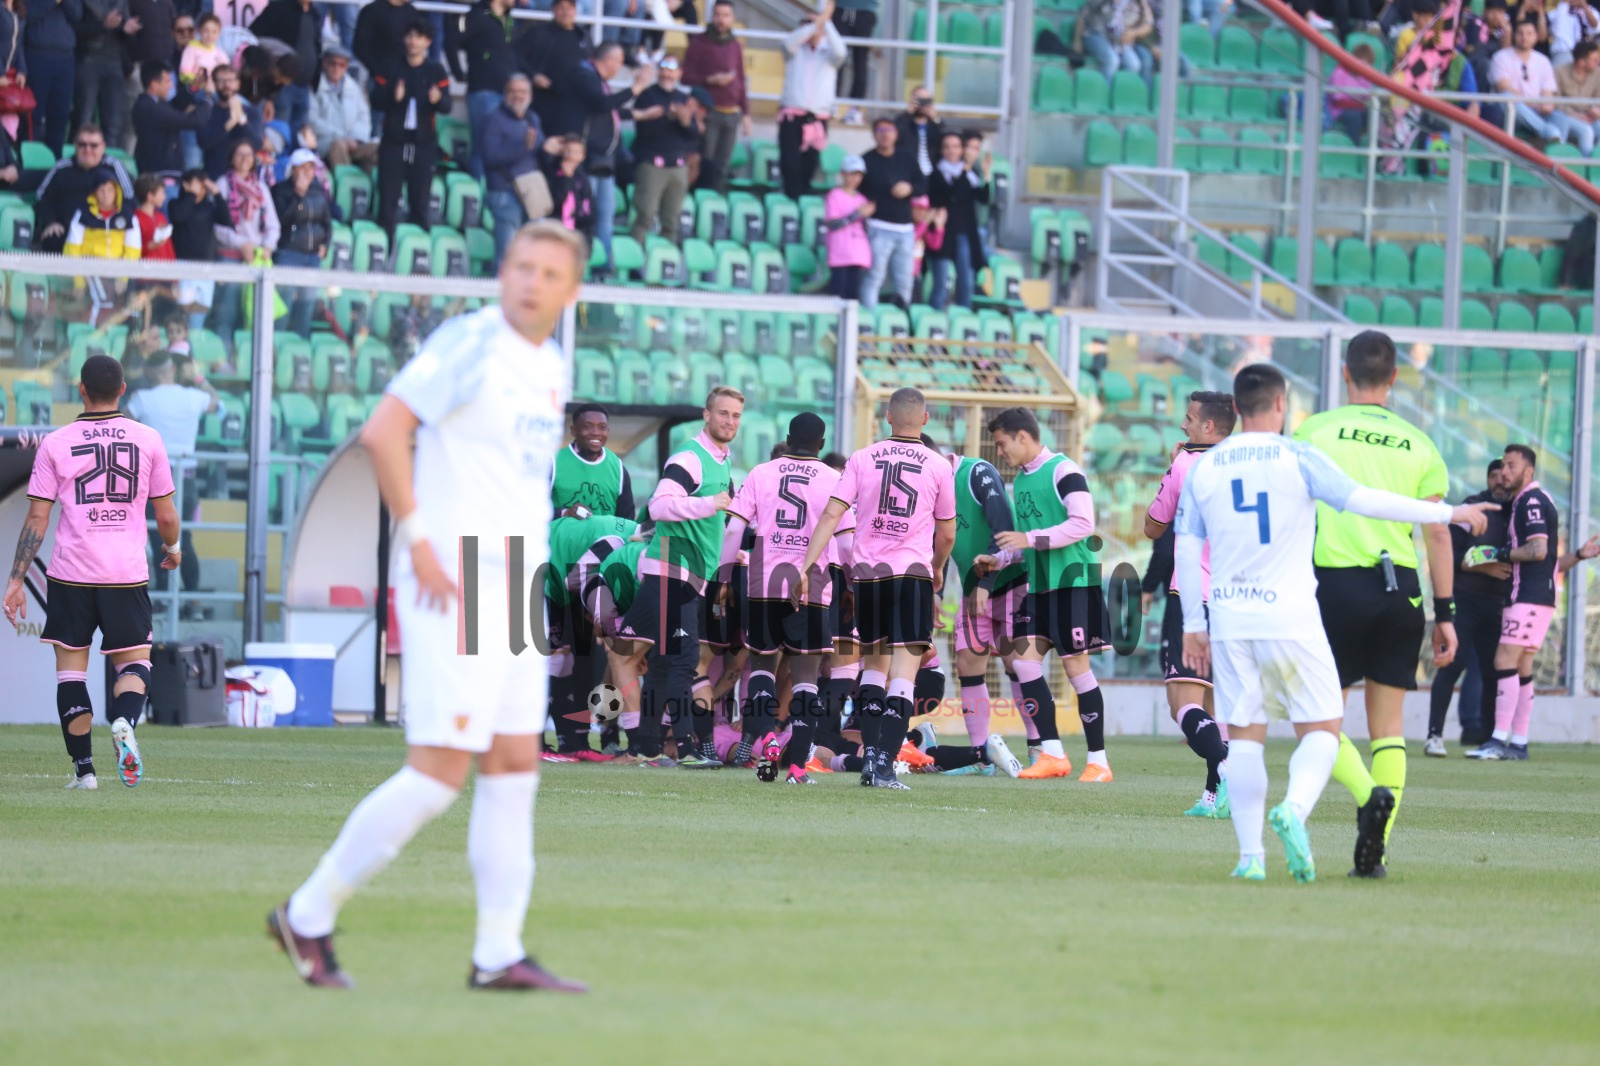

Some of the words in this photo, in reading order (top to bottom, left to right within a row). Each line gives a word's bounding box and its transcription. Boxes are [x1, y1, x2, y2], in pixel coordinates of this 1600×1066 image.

[82, 427, 126, 440] SARIC
[1338, 427, 1411, 451] LEGEA
[870, 446, 928, 465] MARCONI
[1213, 445, 1281, 466] ACAMPORA
[70, 441, 140, 505] 28
[778, 462, 819, 478] GOMES
[874, 460, 922, 518] 15
[775, 474, 810, 530] 5
[1231, 478, 1271, 545] 4
[100, 509, 127, 522] a29
[886, 520, 909, 533] a29
[785, 534, 810, 547] a29
[1213, 586, 1277, 604] RUMMO
